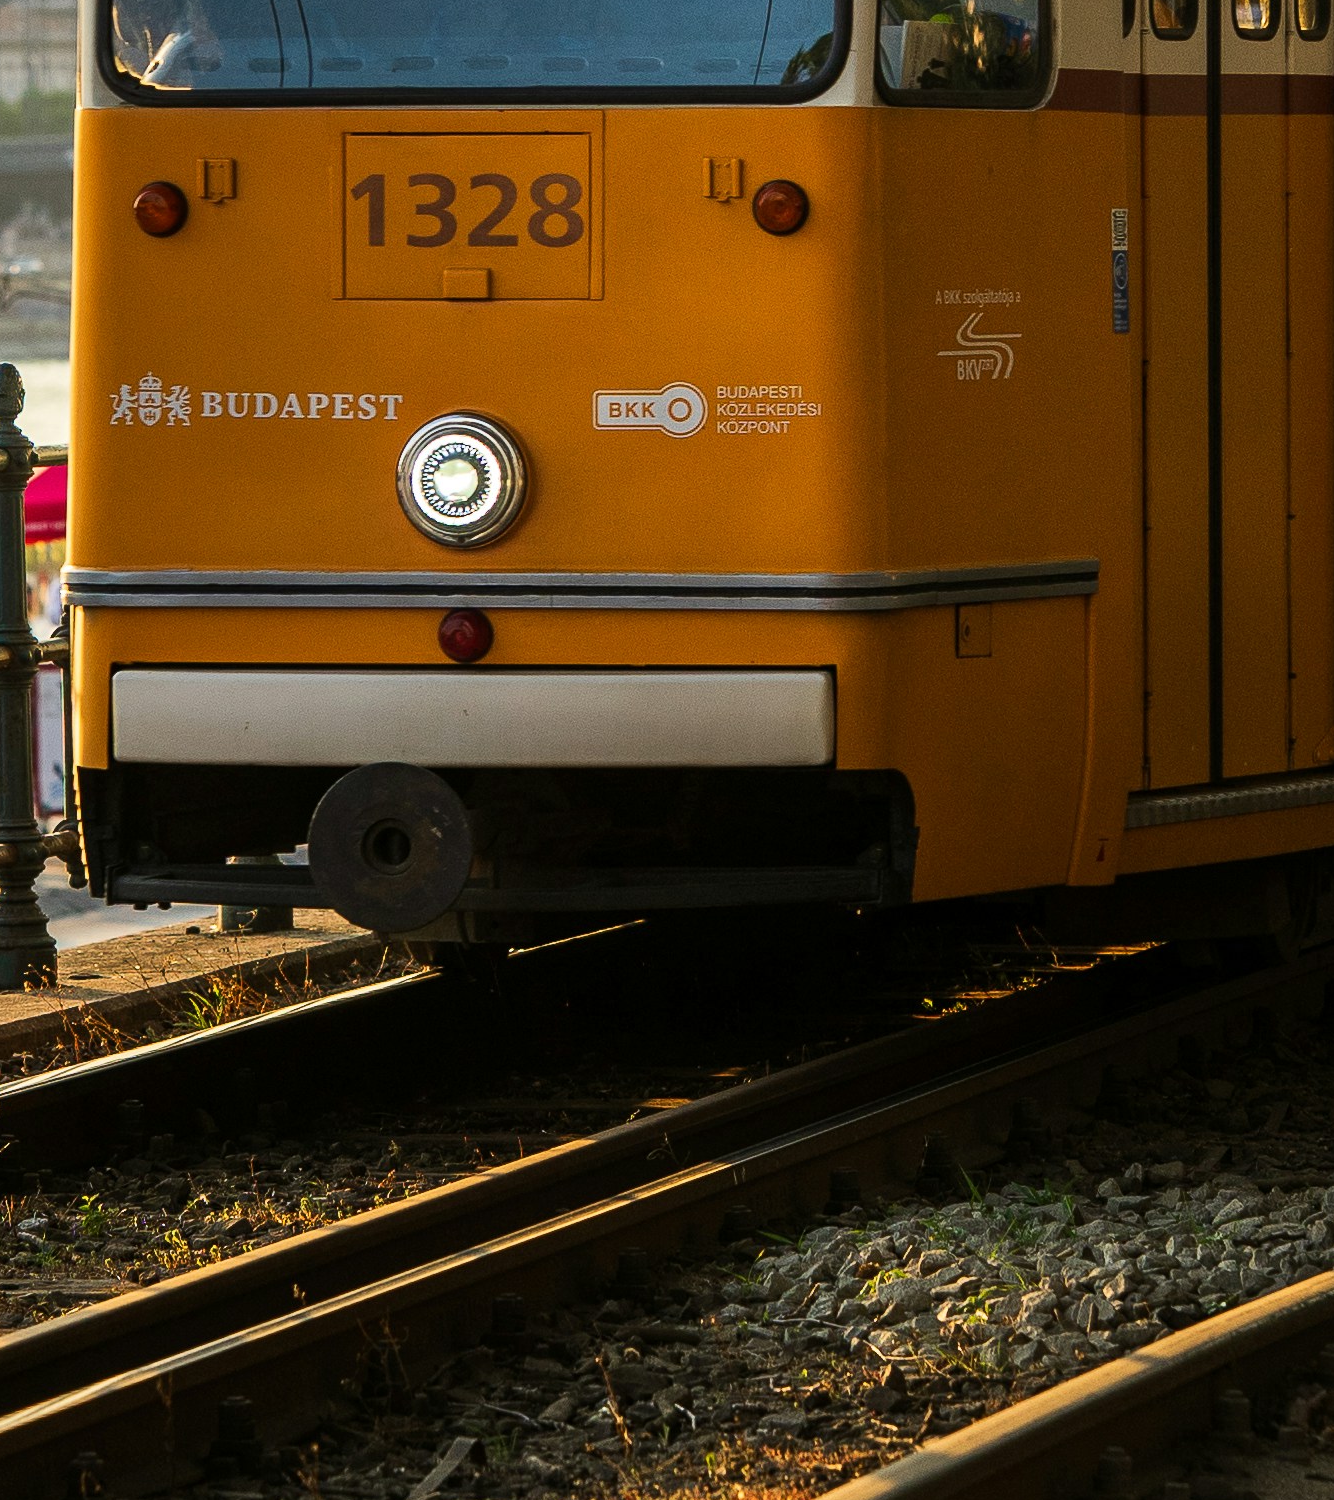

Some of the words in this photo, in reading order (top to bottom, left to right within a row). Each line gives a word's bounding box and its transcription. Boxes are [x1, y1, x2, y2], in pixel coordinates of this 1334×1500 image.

[350, 172, 585, 248] 1328
[957, 359, 981, 380] BKV
[717, 385, 803, 399] BUDAPESTI
[200, 392, 404, 421] BUDAPEST
[608, 402, 656, 419] BKK
[717, 400, 822, 416] KÖZLEKEDÉSI
[717, 419, 790, 434] KÖZPONT
